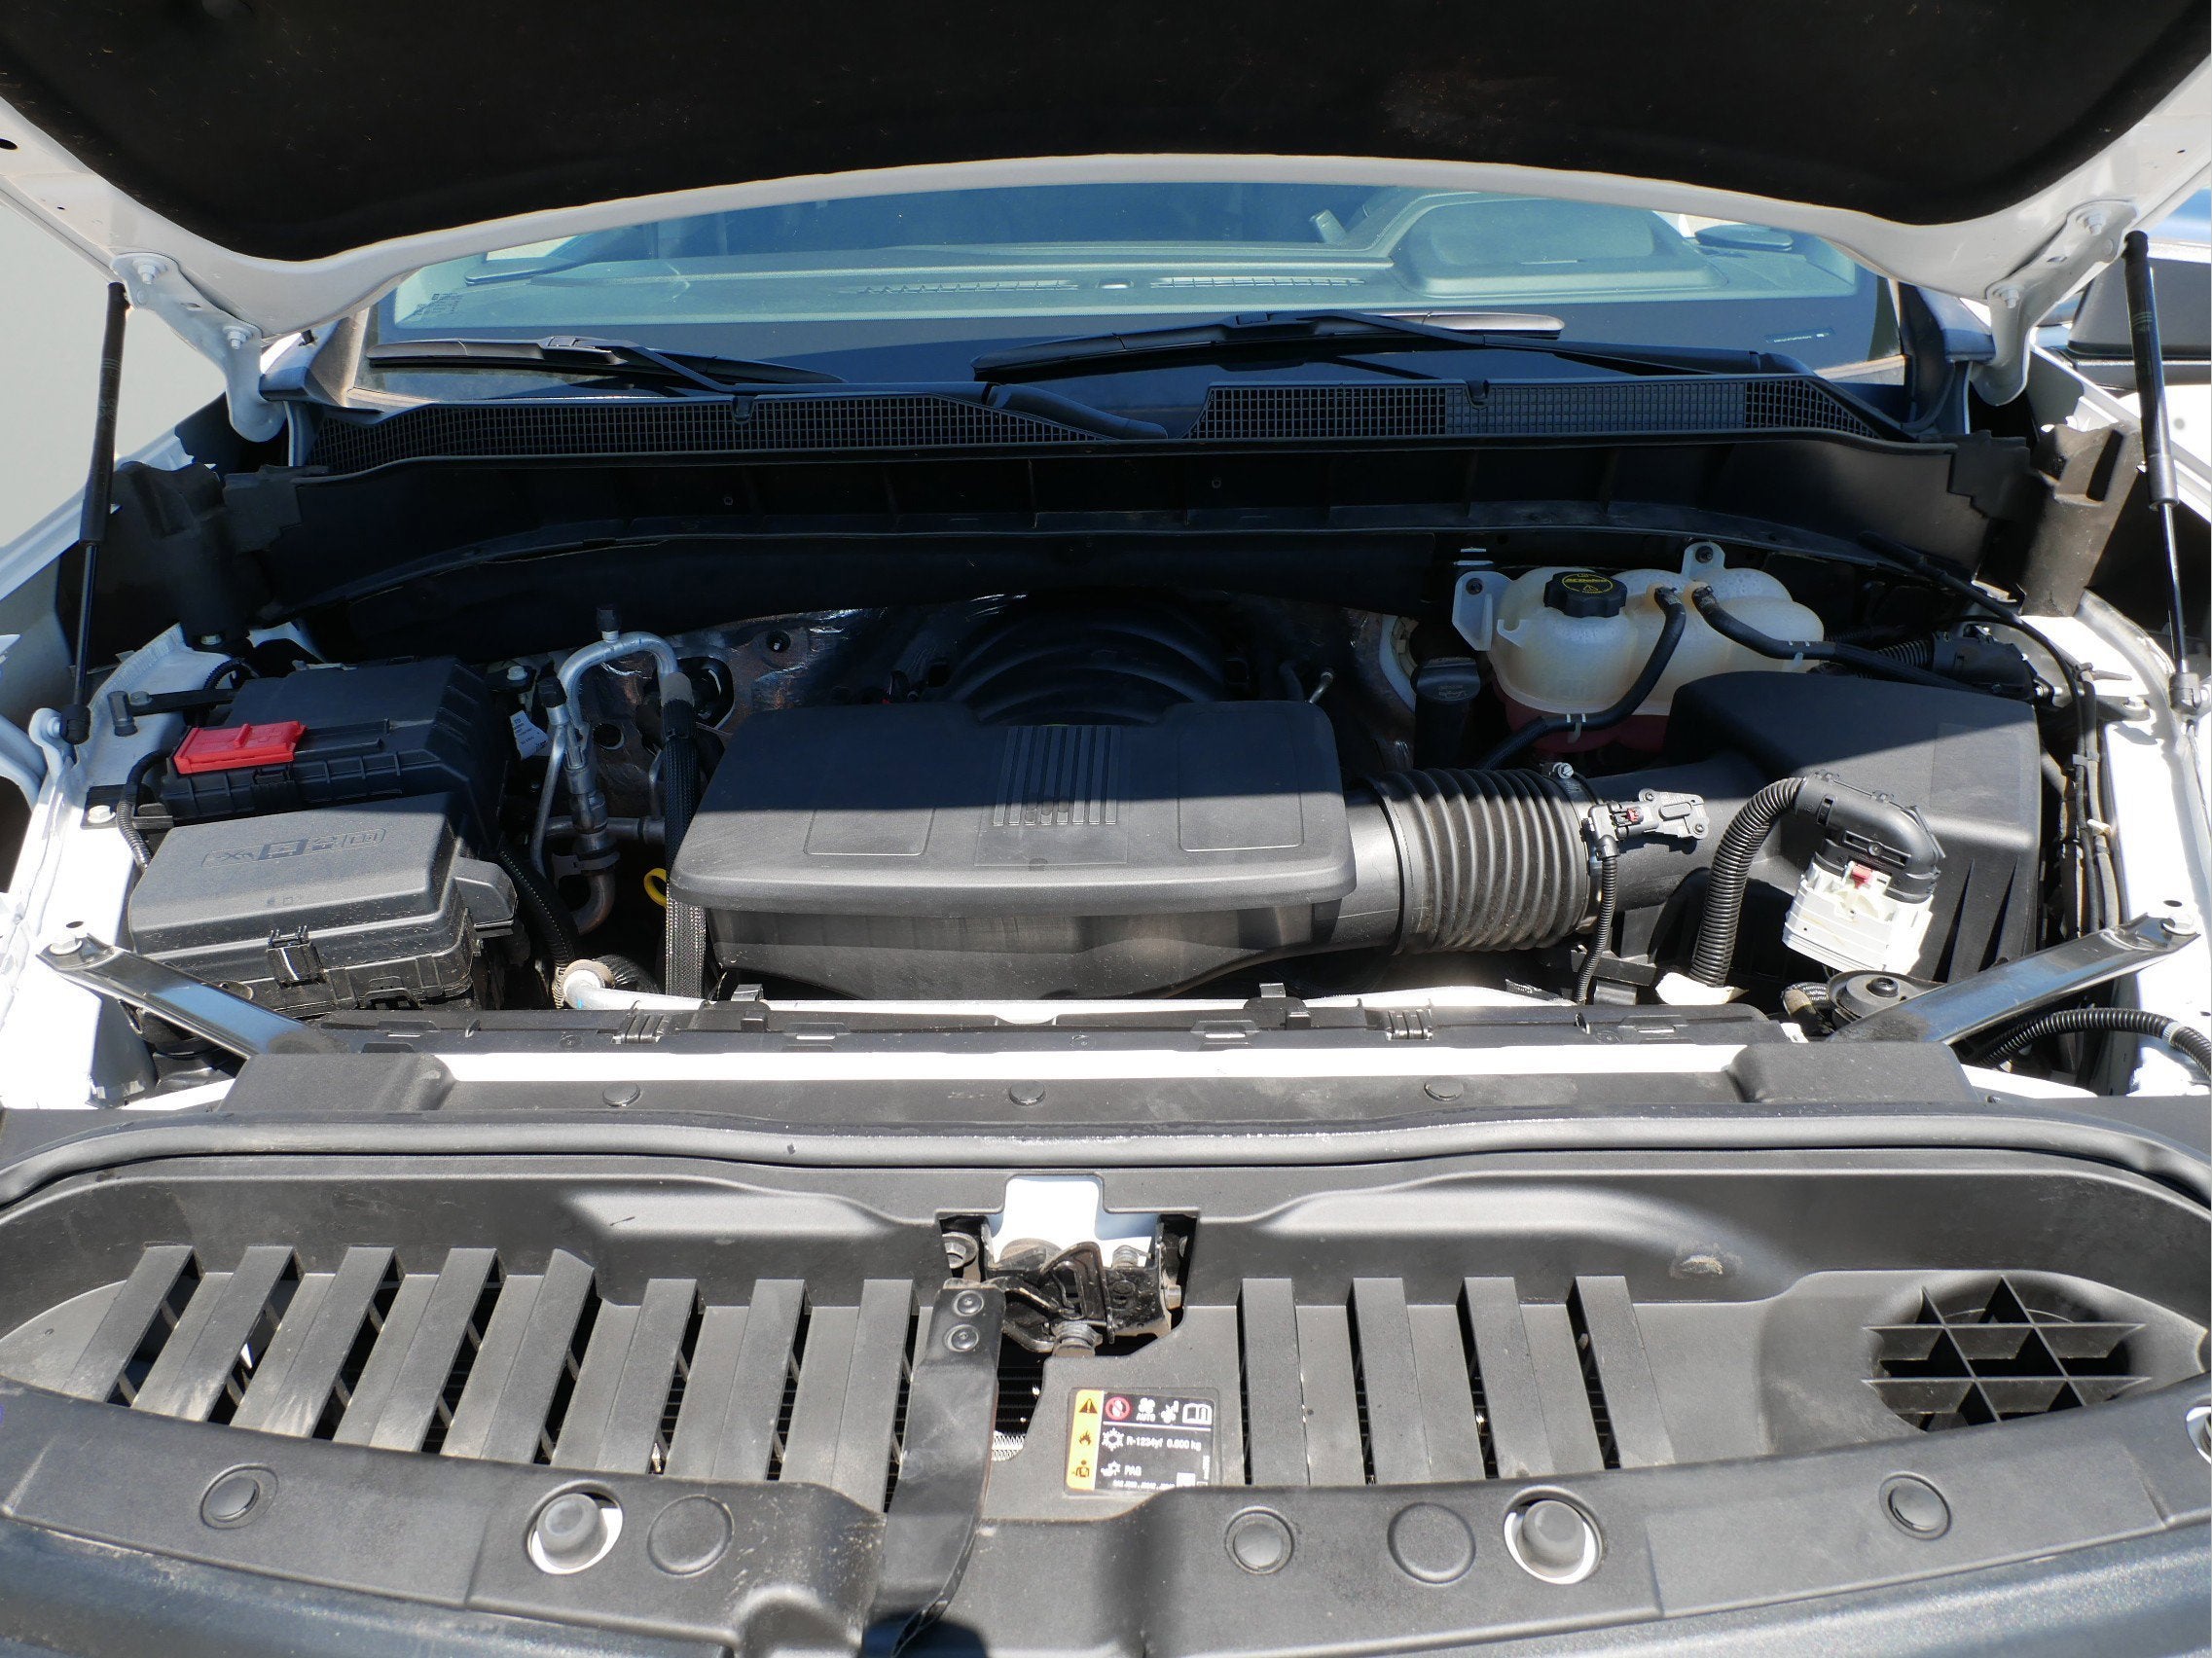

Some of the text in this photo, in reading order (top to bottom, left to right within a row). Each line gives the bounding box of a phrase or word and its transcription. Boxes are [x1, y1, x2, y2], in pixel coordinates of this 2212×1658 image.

[1136, 1412, 1156, 1422] AUTO
[1126, 1435, 1163, 1449] R-1234yf
[1190, 1439, 1202, 1452] kg
